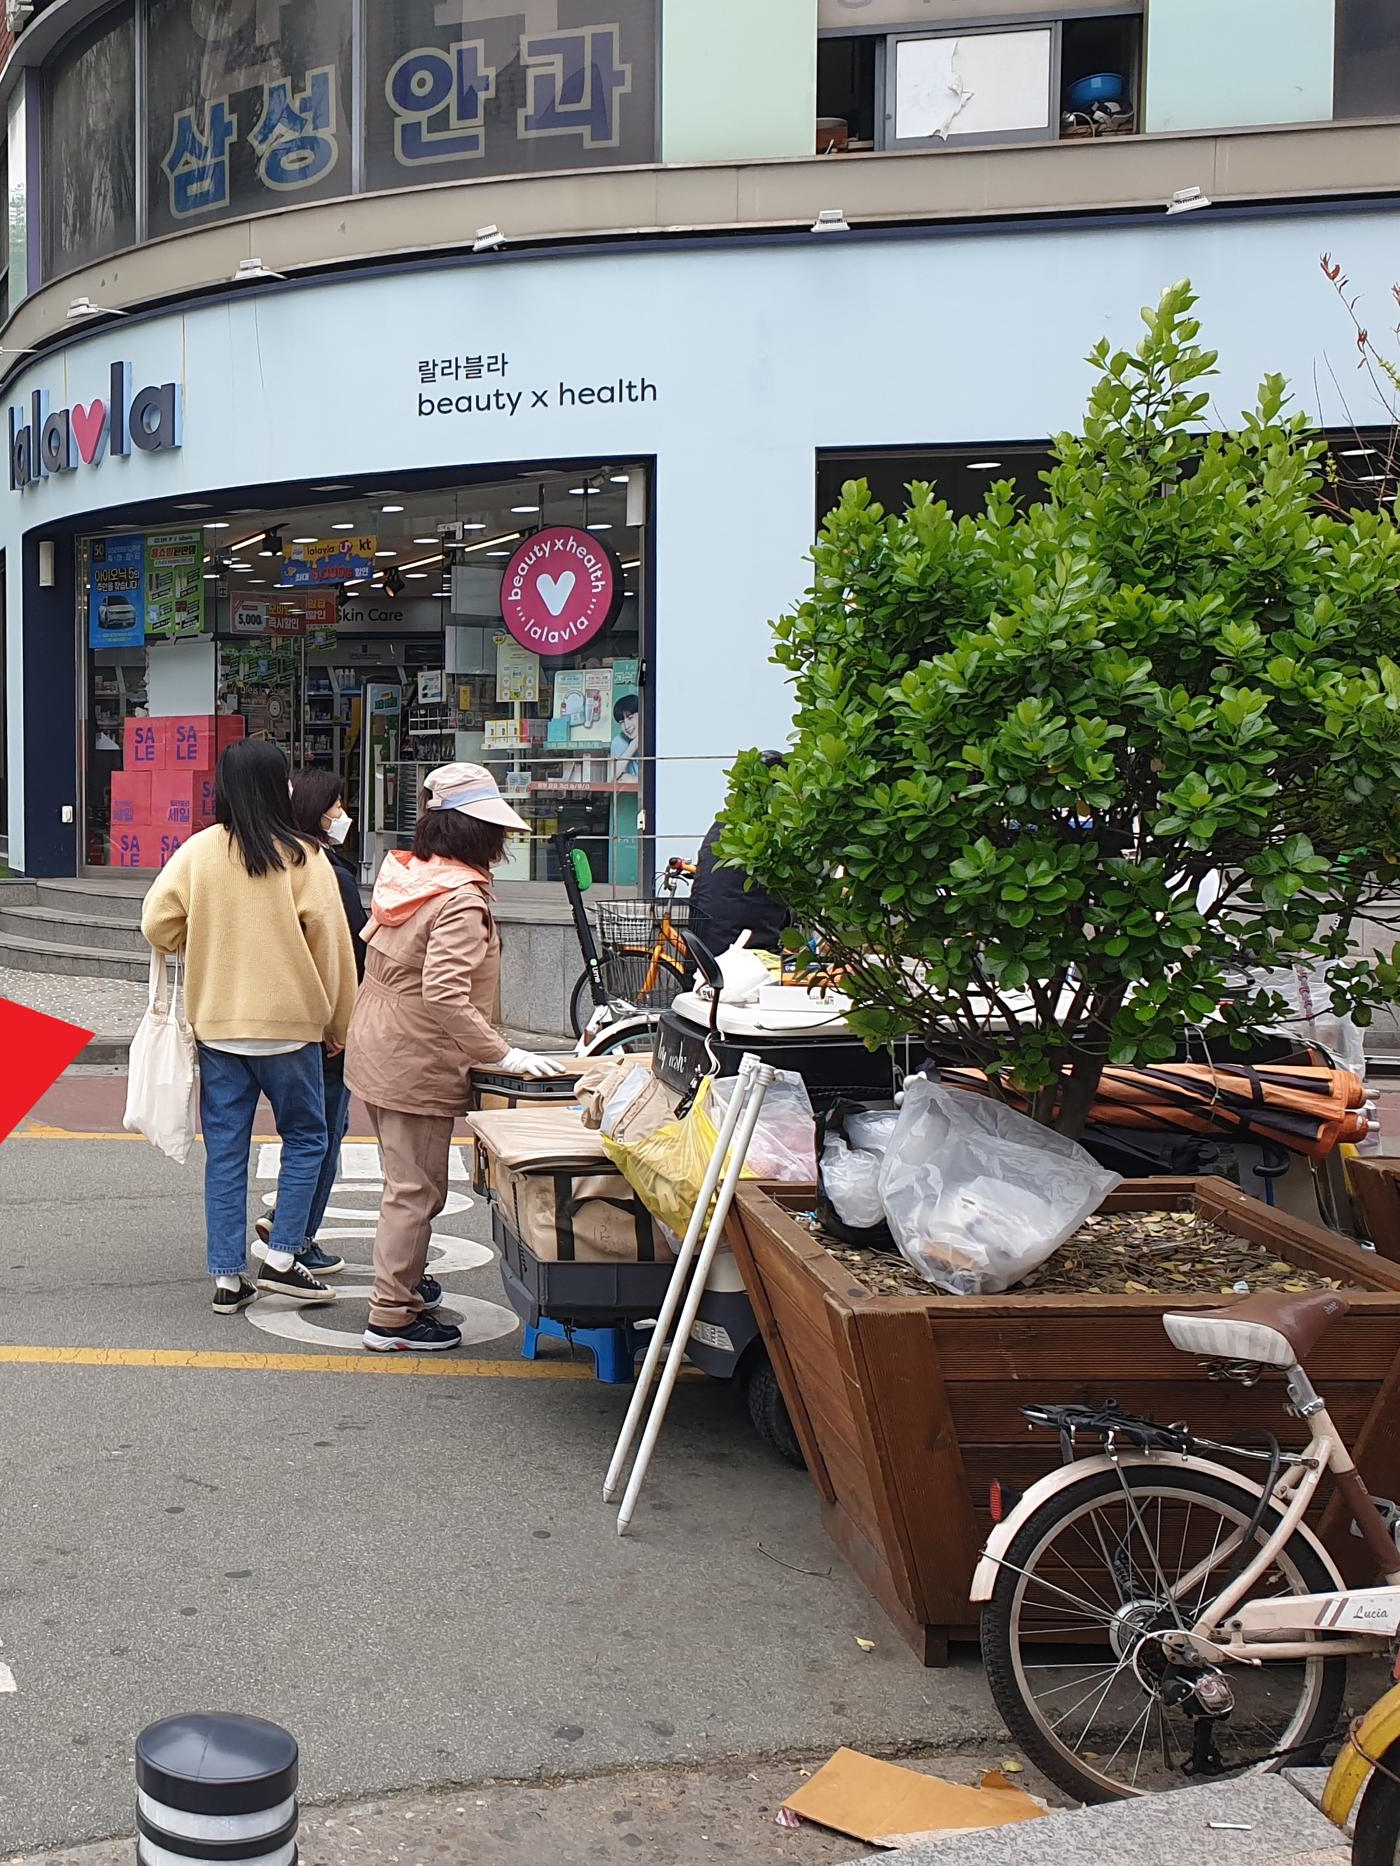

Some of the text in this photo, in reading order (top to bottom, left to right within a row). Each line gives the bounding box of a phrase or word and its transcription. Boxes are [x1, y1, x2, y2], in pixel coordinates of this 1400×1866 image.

[385, 23, 632, 167] 안과
[418, 352, 509, 384] 랄라블라
[418, 377, 657, 417] beauty x health
[507, 540, 551, 601] beauty
[566, 535, 606, 593] health
[368, 610, 403, 622] Care
[524, 615, 589, 643] lalavla
[135, 727, 155, 744] SA
[176, 726, 197, 743] SA
[135, 745, 155, 761] LE
[176, 744, 197, 760] LE
[168, 808, 190, 822] 세일
[120, 835, 140, 852] SA
[1352, 1605, 1389, 1619] Lucia
